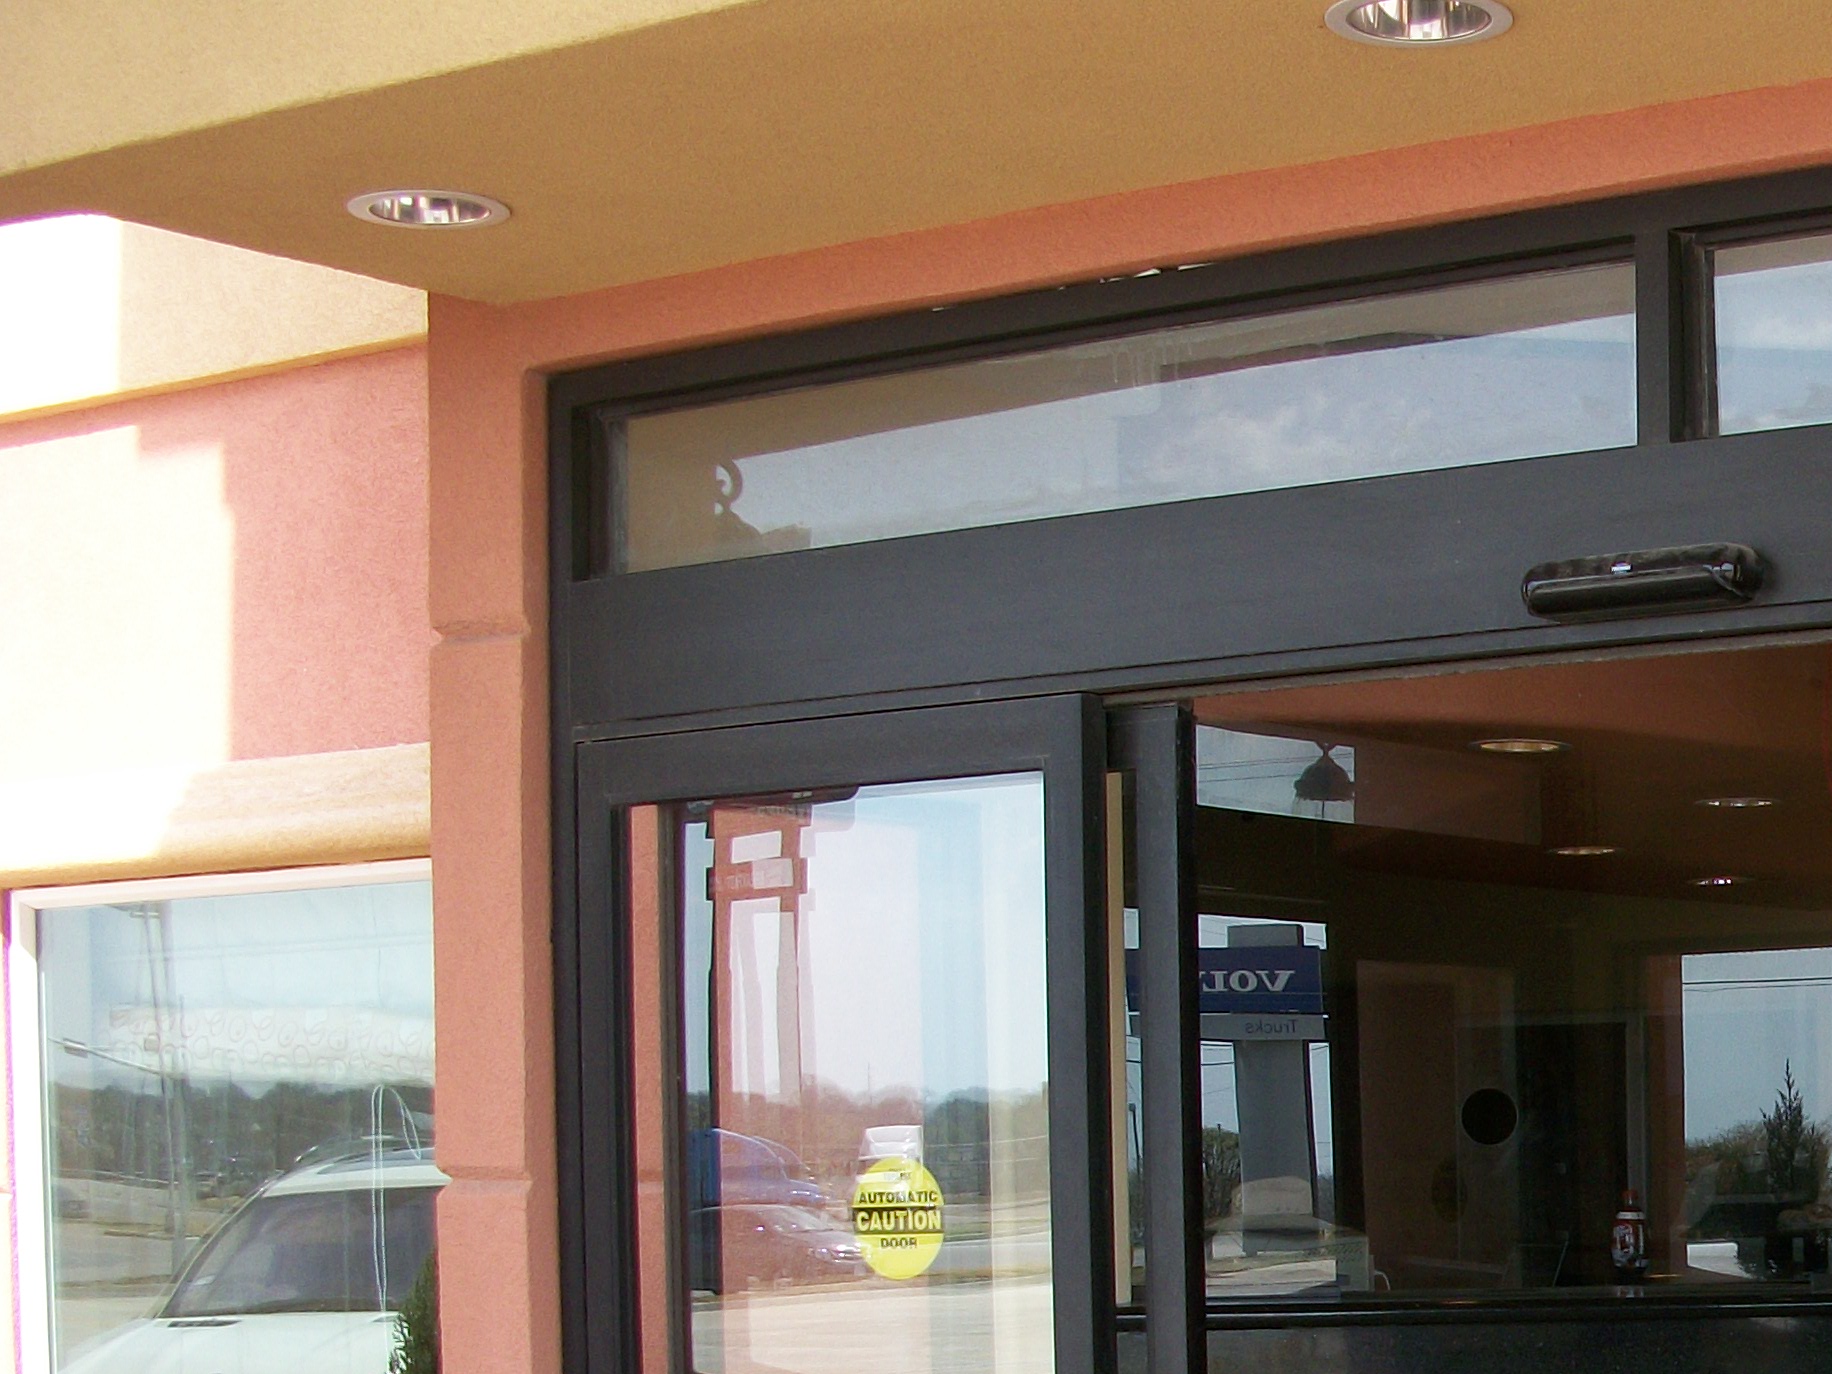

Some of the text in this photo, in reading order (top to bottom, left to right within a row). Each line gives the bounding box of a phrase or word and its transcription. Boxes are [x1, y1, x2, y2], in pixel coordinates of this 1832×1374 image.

[859, 1190, 938, 1204] AUTOMATIC
[856, 1209, 941, 1231] CAUTION
[880, 1237, 917, 1249] DOOR
